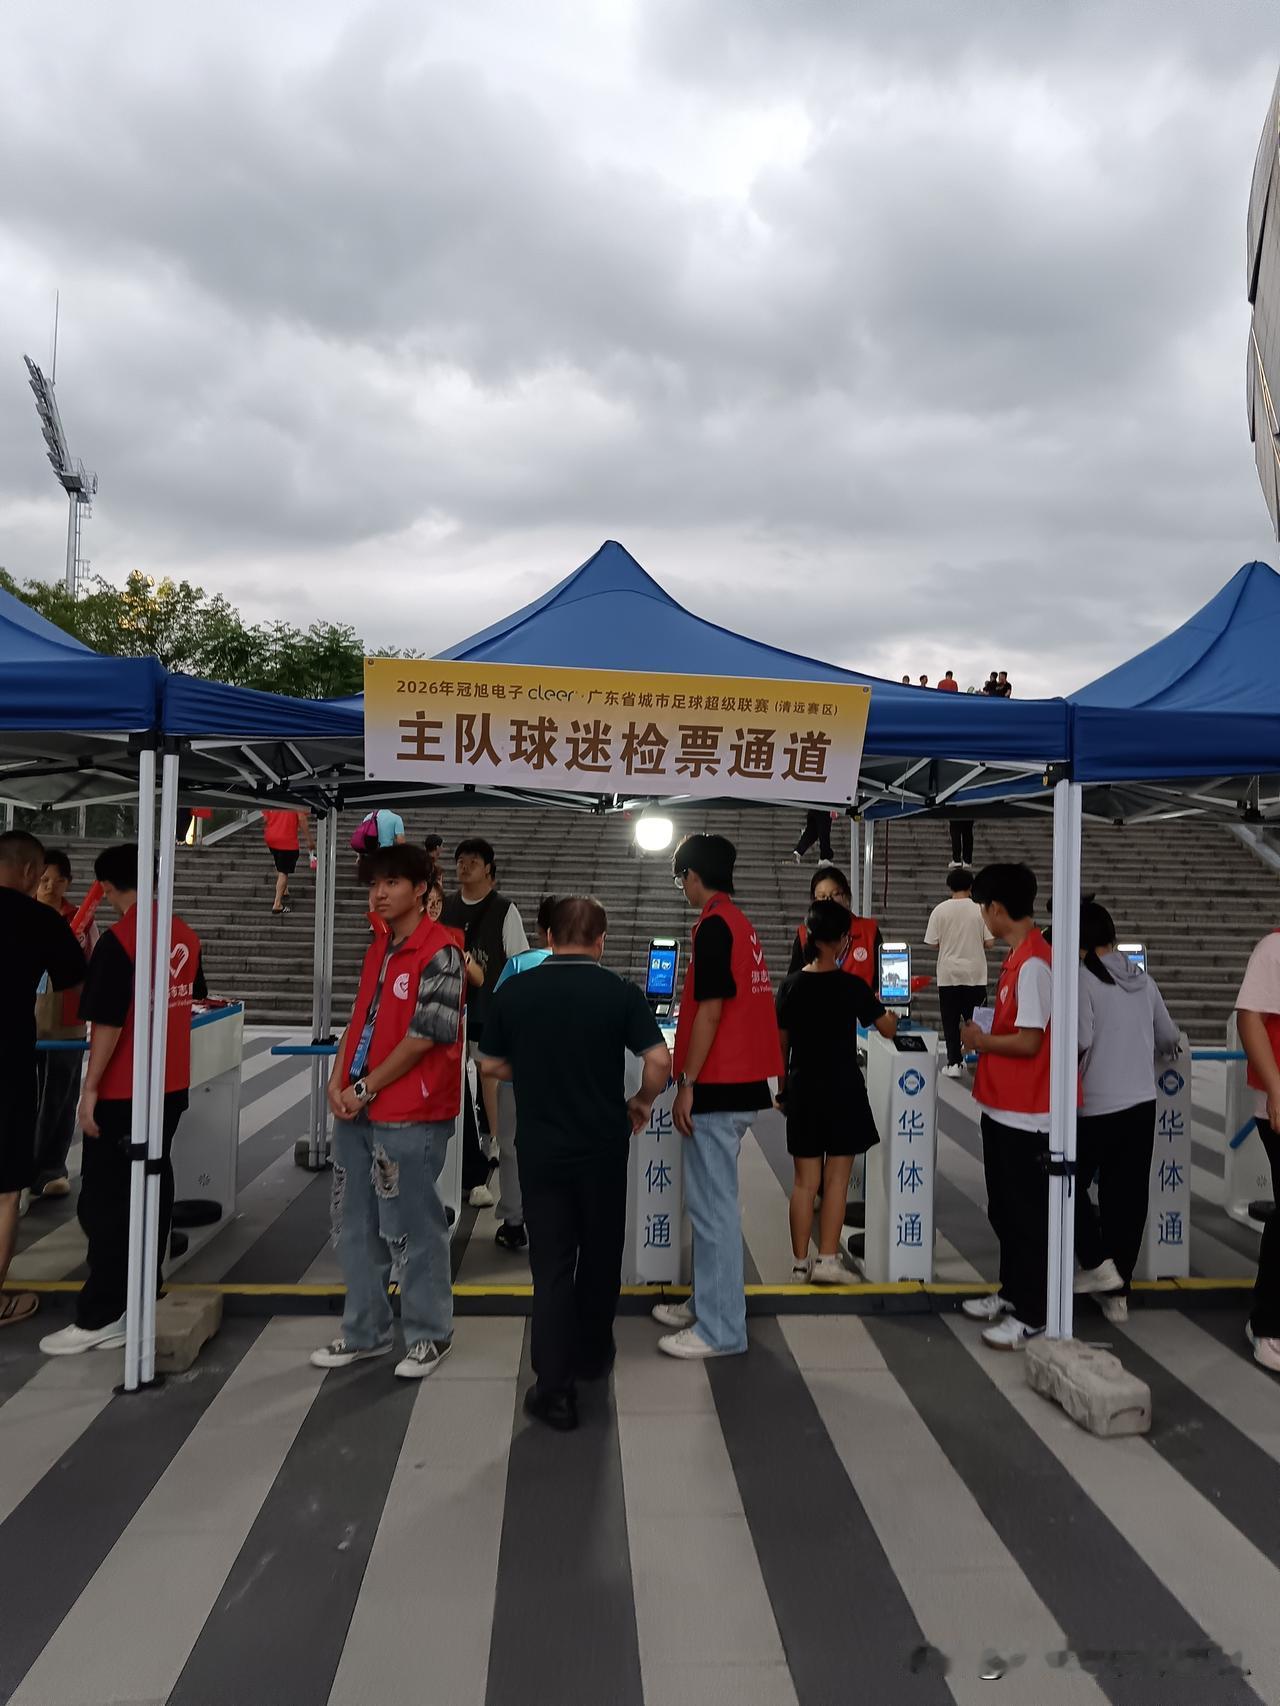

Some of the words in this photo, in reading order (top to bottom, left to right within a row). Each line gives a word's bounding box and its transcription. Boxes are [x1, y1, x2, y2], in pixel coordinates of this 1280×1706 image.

[396, 680, 524, 700] 2026年冠旭电子
[528, 685, 575, 702] cleer
[396, 710, 832, 784] 主队球迷检票通道
[643, 1107, 673, 1249] 华体通
[896, 1109, 925, 1247] 华体通
[1158, 1109, 1184, 1246] 华体通
